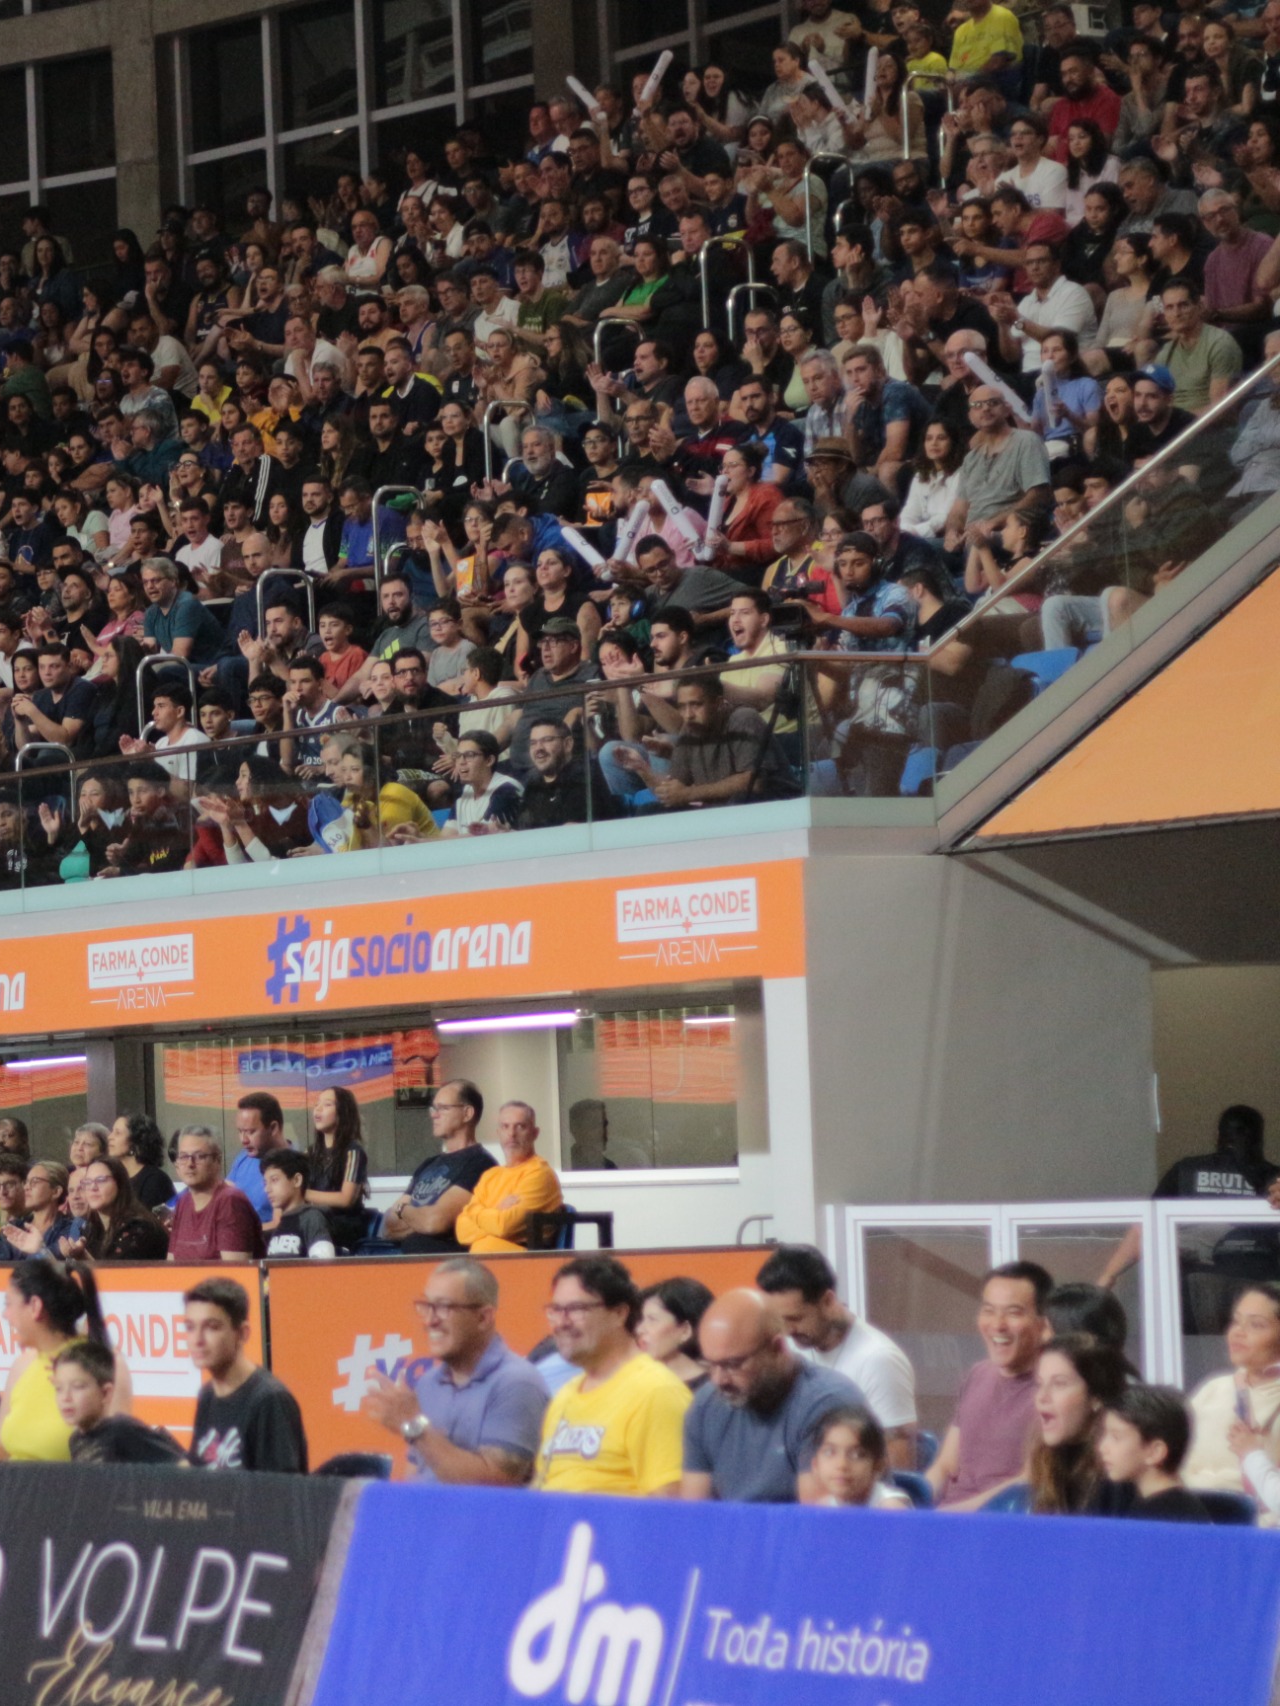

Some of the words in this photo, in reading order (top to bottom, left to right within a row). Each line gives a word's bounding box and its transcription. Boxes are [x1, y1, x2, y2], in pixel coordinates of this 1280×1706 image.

[622, 897, 680, 922] FARMA
[689, 890, 751, 917] CONDE
[92, 949, 137, 972] FARMA
[141, 944, 189, 968] CONDE
[265, 913, 531, 1004] #sejasocioarena
[656, 939, 719, 965] ARENA
[118, 986, 166, 1010] ARENA
[104, 1314, 191, 1358] ONDE
[143, 1500, 173, 1519] VILA
[176, 1502, 209, 1521] EMA
[41, 1537, 289, 1665] VOLPE
[706, 1607, 789, 1670] Toda
[795, 1618, 930, 1683] história
